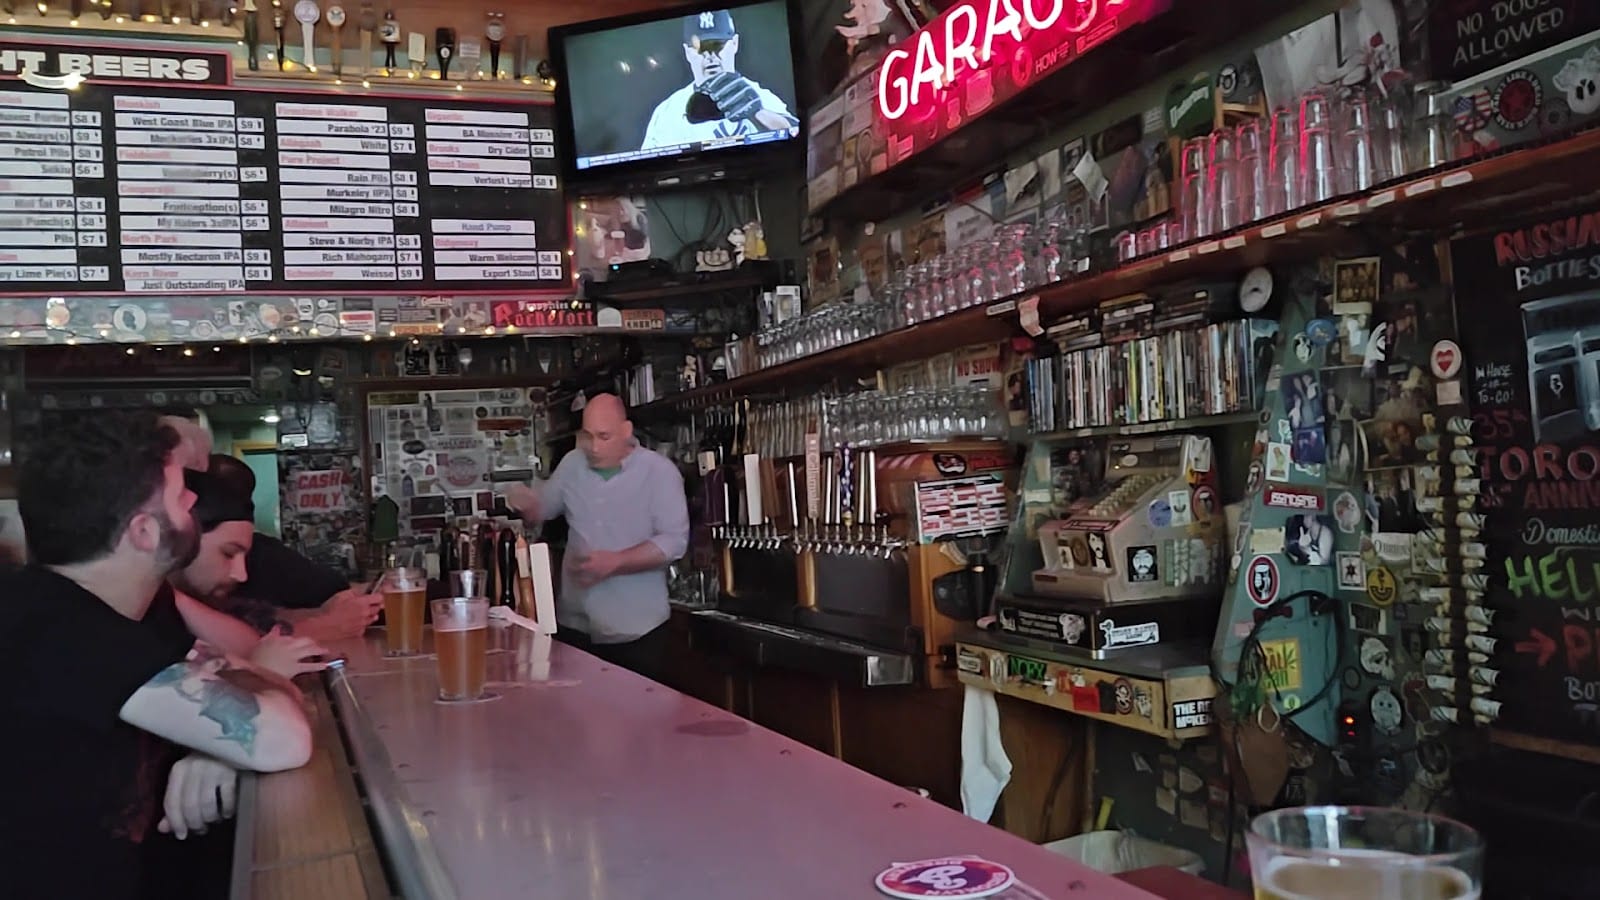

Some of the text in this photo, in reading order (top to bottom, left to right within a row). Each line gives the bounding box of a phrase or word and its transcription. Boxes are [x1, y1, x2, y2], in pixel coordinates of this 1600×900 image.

[1456, 0, 1549, 39] NO DO
[1453, 7, 1564, 68] ALLOWED
[58, 53, 210, 81] BEERS
[74, 114, 88, 123] $8
[132, 117, 158, 126] West
[161, 117, 188, 127] Coast
[217, 119, 234, 128] IPA
[241, 121, 253, 129] $9
[328, 124, 369, 133] Parabola
[391, 127, 403, 135] $9
[76, 132, 90, 141] $9
[240, 137, 253, 146] $8
[393, 142, 405, 150] $7
[488, 146, 503, 155] Dry
[506, 146, 527, 155] Cider
[77, 164, 90, 174] $6
[347, 174, 368, 182] Rain
[507, 177, 531, 187] Lager
[56, 199, 73, 208] IPA
[245, 219, 257, 227] $6
[82, 235, 95, 243] $7
[338, 237, 345, 245] &
[377, 236, 392, 245] IPA
[398, 238, 410, 246] $8
[224, 252, 240, 260] IPA
[247, 252, 259, 261] $9
[322, 253, 343, 262] Rich
[400, 253, 411, 261] $7
[469, 254, 495, 262] Warm
[16, 270, 42, 278] Lime
[82, 269, 96, 278] $7
[247, 270, 259, 278] $8
[401, 269, 412, 278] $9
[482, 269, 536, 278] Export Stout
[165, 281, 226, 290] Outstanding
[229, 280, 245, 288] IPA
[494, 303, 593, 326] Rochefort
[298, 473, 341, 490] CASH
[300, 492, 341, 509] ONLY
[1010, 657, 1047, 681] NOFX
[1173, 702, 1196, 716] THE
